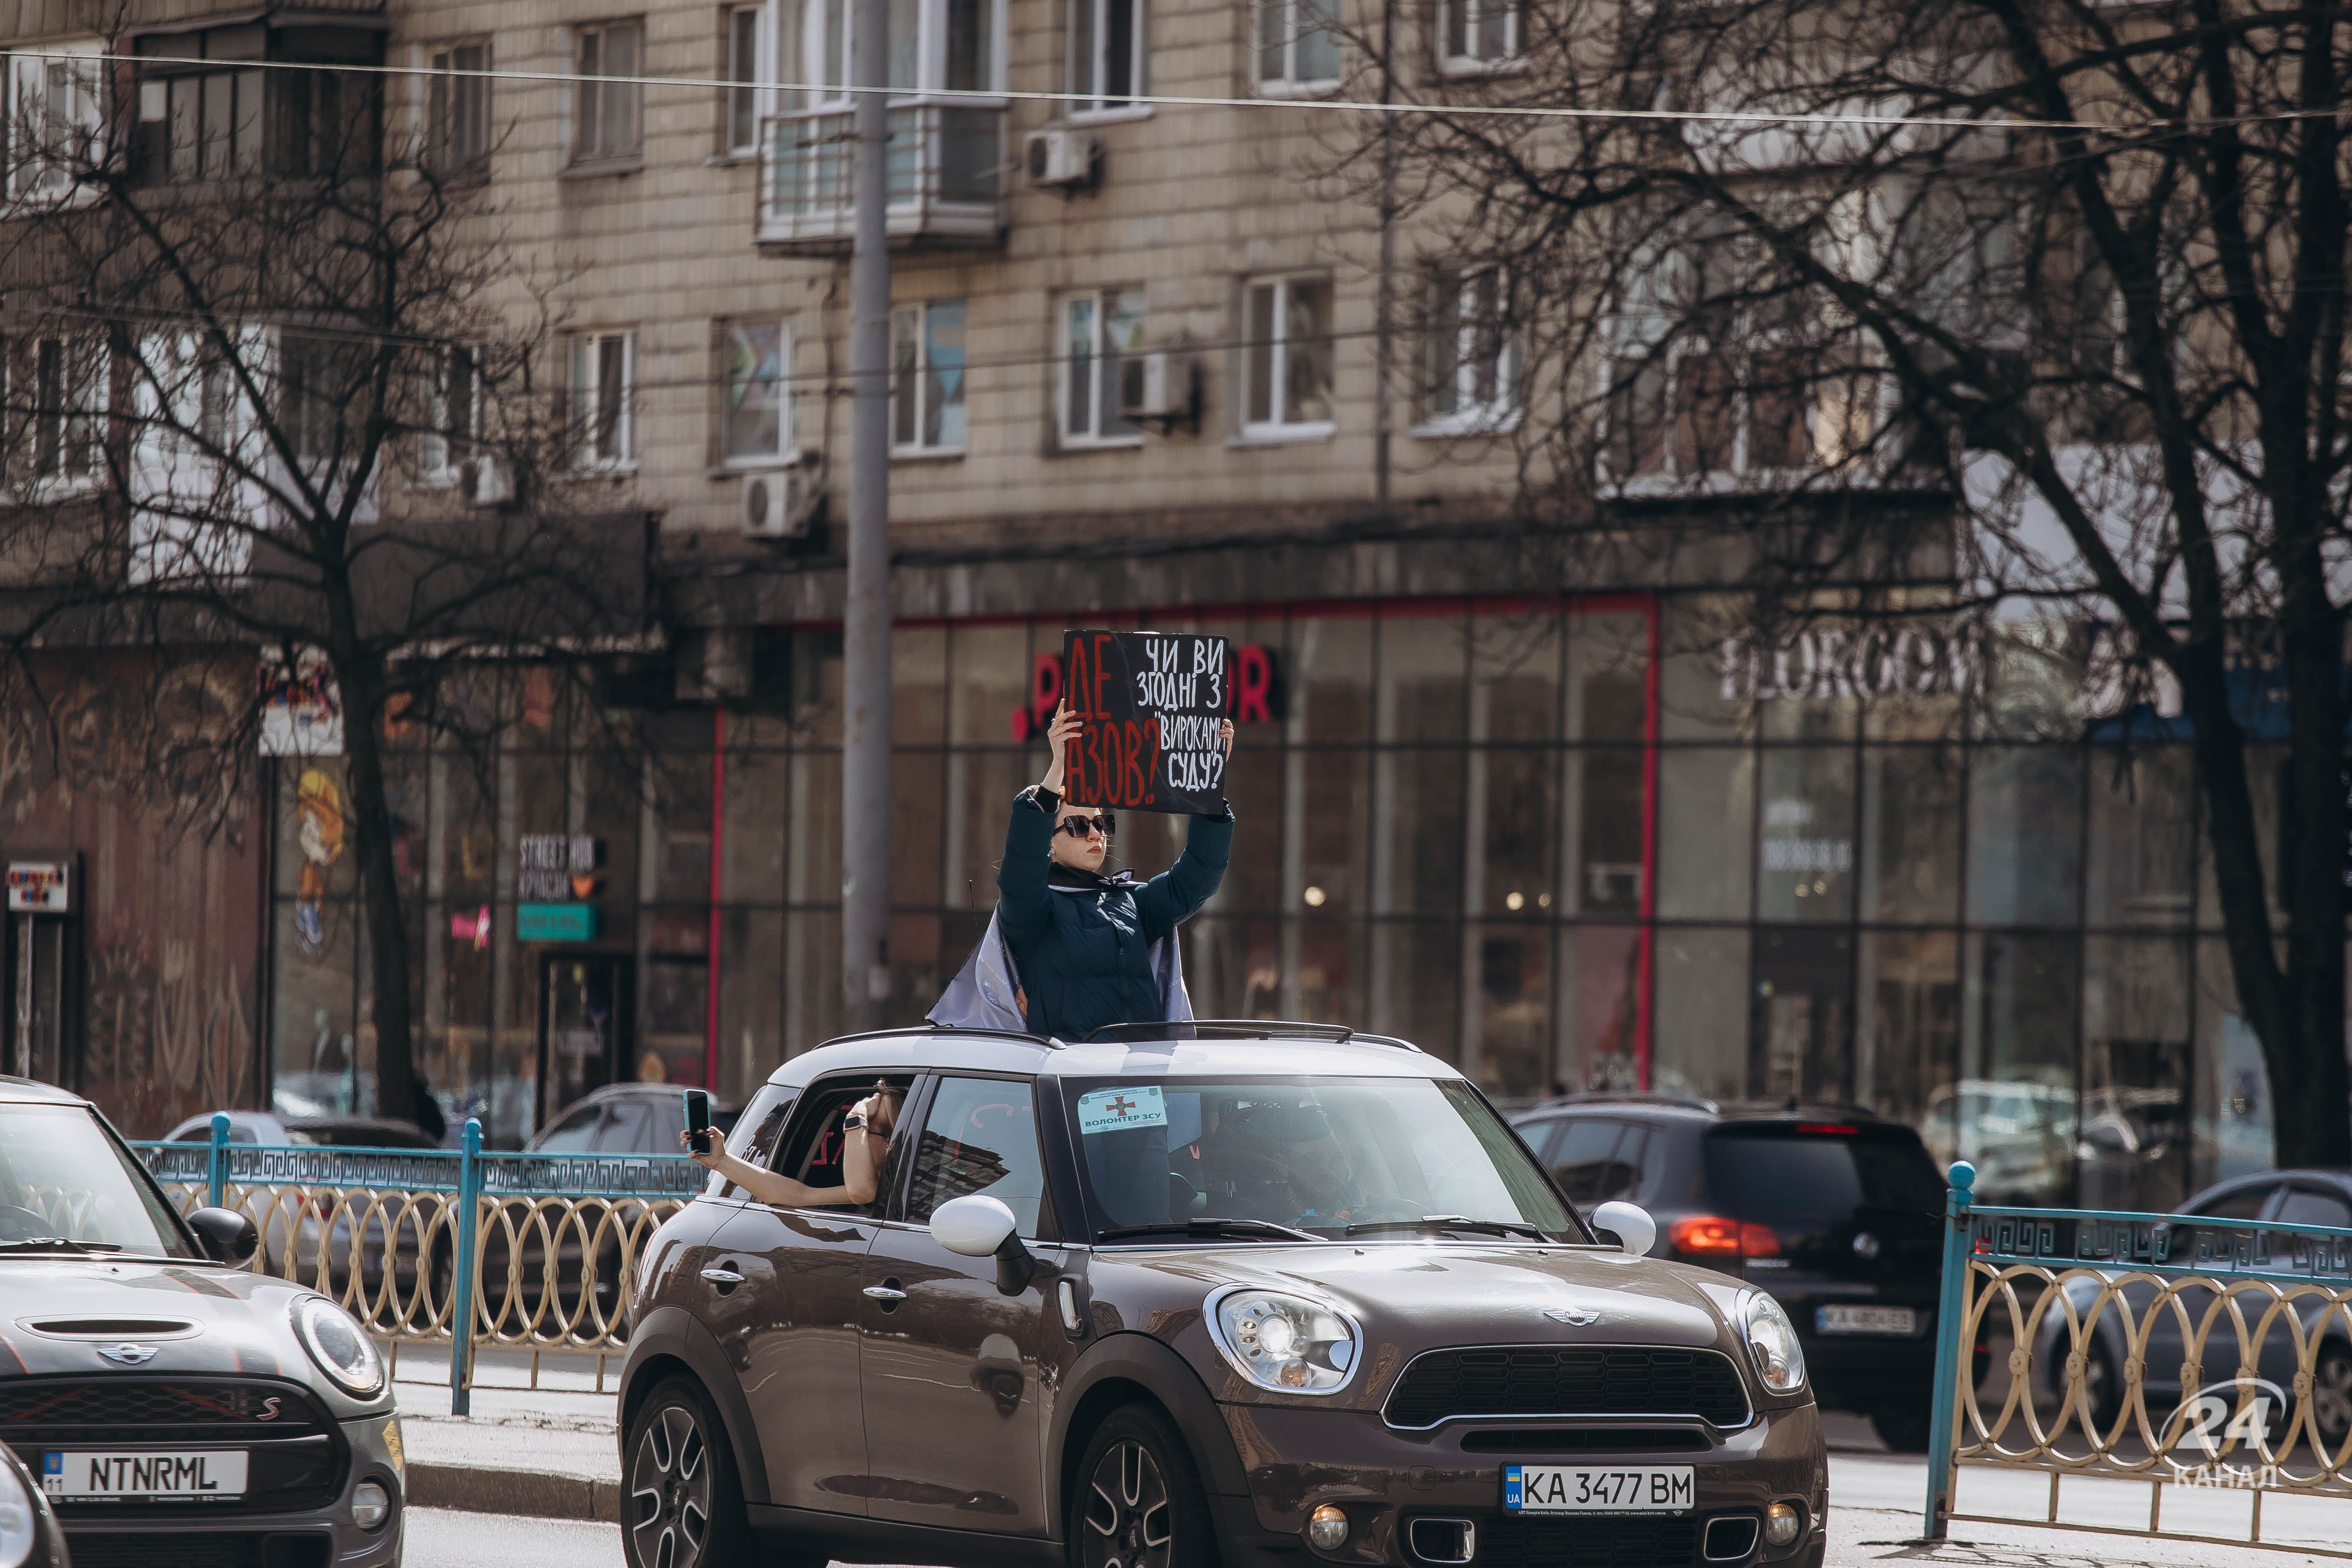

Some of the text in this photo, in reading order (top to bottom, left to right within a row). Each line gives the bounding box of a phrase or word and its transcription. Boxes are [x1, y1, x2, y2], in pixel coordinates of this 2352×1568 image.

[1146, 639, 1224, 675] ЧИ ВИ
[1068, 634, 1112, 723] ДЕ
[1067, 718, 1160, 807] АЗОВ?
[1085, 1115, 1140, 1127] ВОЛОНТЕР
[46, 1478, 63, 1492] 11
[89, 1457, 218, 1491] NTNRML
[1524, 1473, 1691, 1504] KA 3477 BM
[1507, 1494, 1520, 1503] UA
